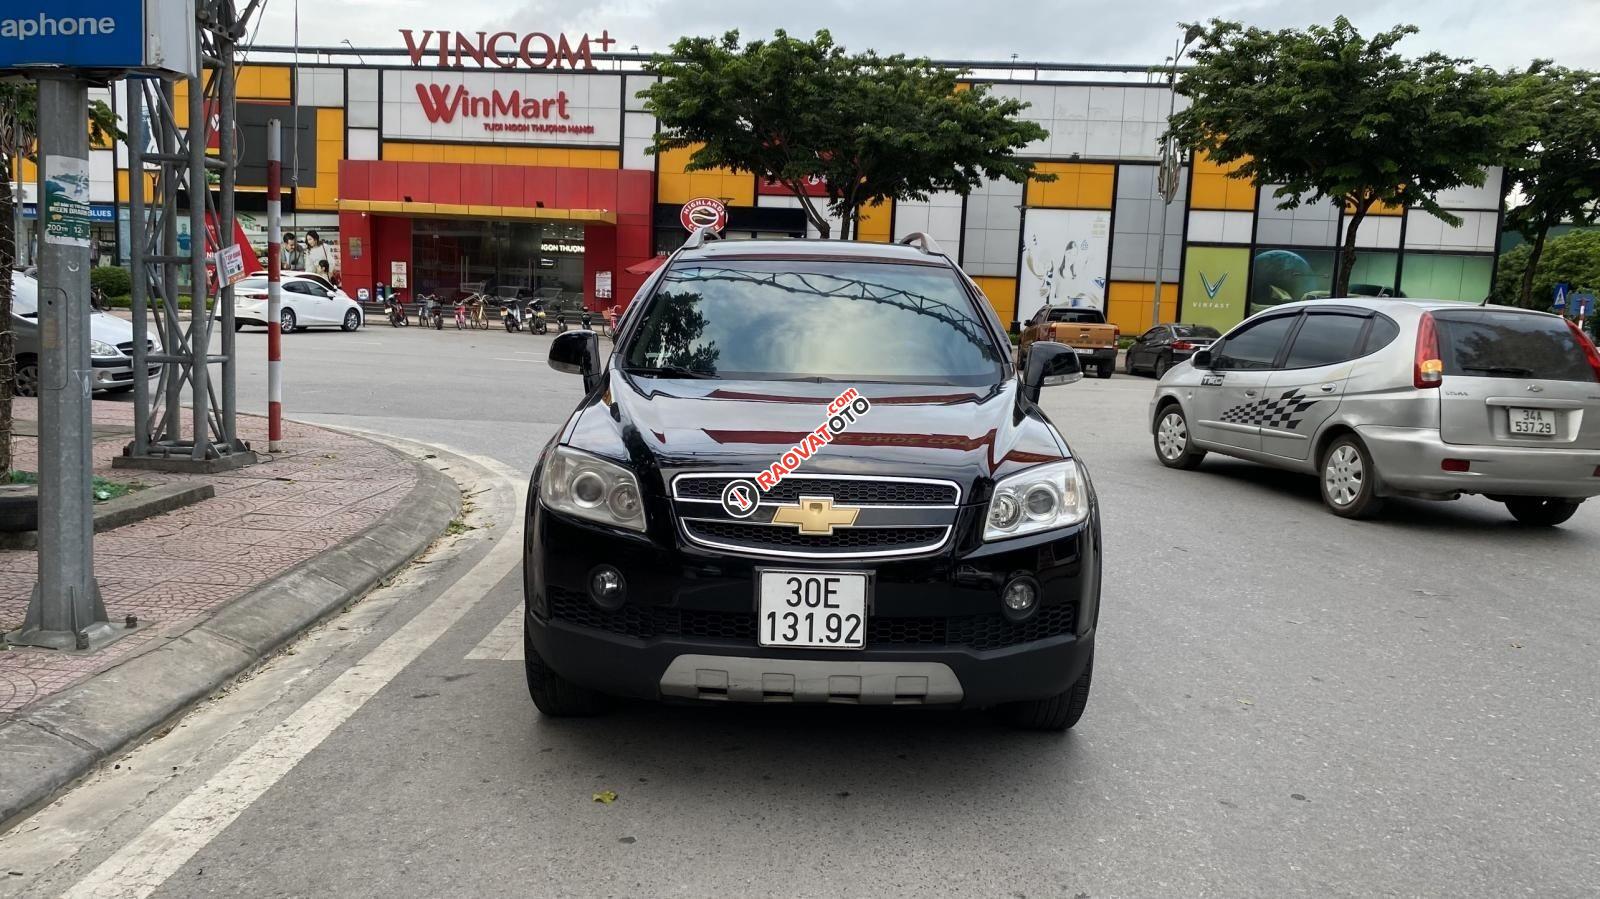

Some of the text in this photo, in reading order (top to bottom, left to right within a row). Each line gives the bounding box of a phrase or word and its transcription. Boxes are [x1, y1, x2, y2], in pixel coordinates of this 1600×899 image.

[415, 83, 570, 124] WinMart
[1515, 421, 1552, 433] 537.29
[1523, 409, 1543, 421] 34A
[785, 576, 841, 609] 30E
[766, 611, 861, 645] 131.92
